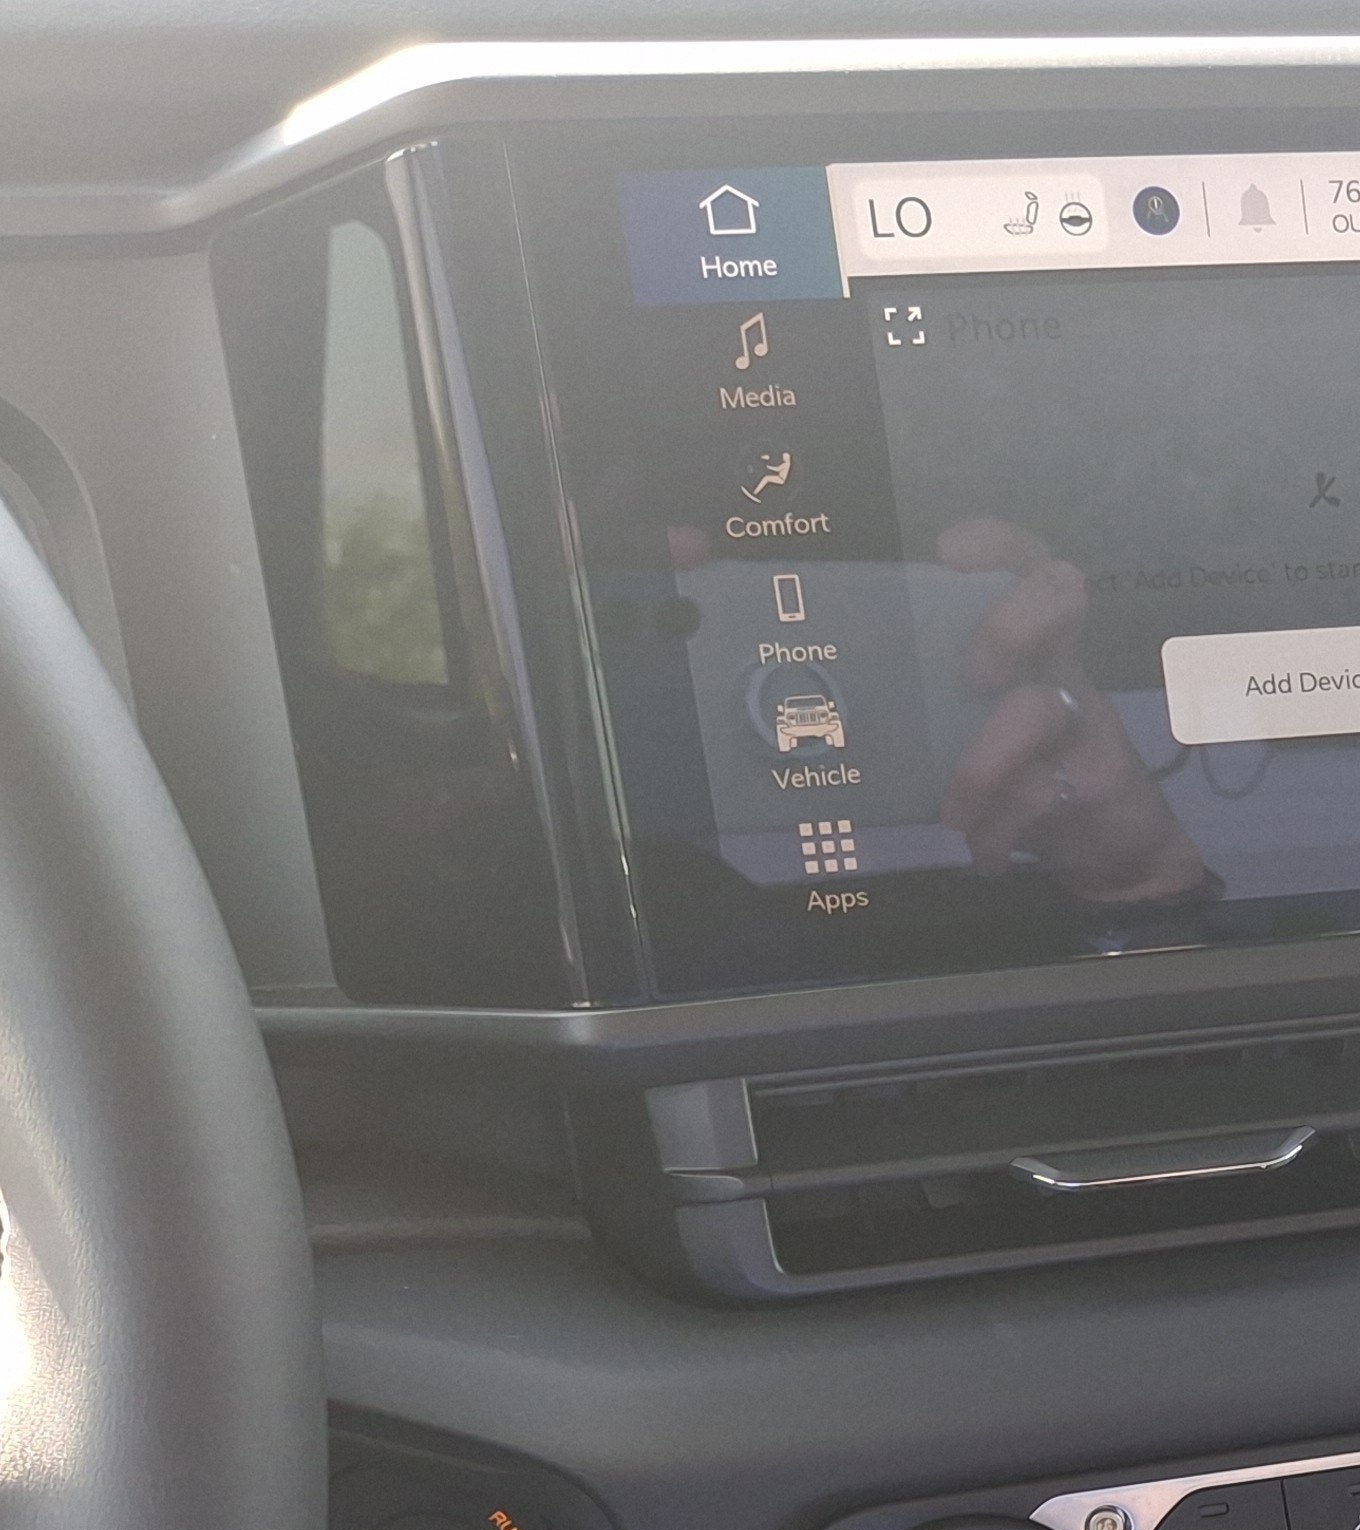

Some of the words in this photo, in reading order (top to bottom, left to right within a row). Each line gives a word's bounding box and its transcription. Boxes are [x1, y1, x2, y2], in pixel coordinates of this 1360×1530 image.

[867, 196, 933, 239] LO
[700, 255, 778, 280] Home
[946, 311, 1063, 343] Phone
[719, 384, 797, 409] Media
[725, 512, 831, 539] Comfort
[1284, 562, 1309, 582] to
[757, 640, 838, 665] Phone
[1244, 673, 1292, 699] Add
[771, 763, 862, 790] Vehicle
[806, 888, 871, 915] Apps
